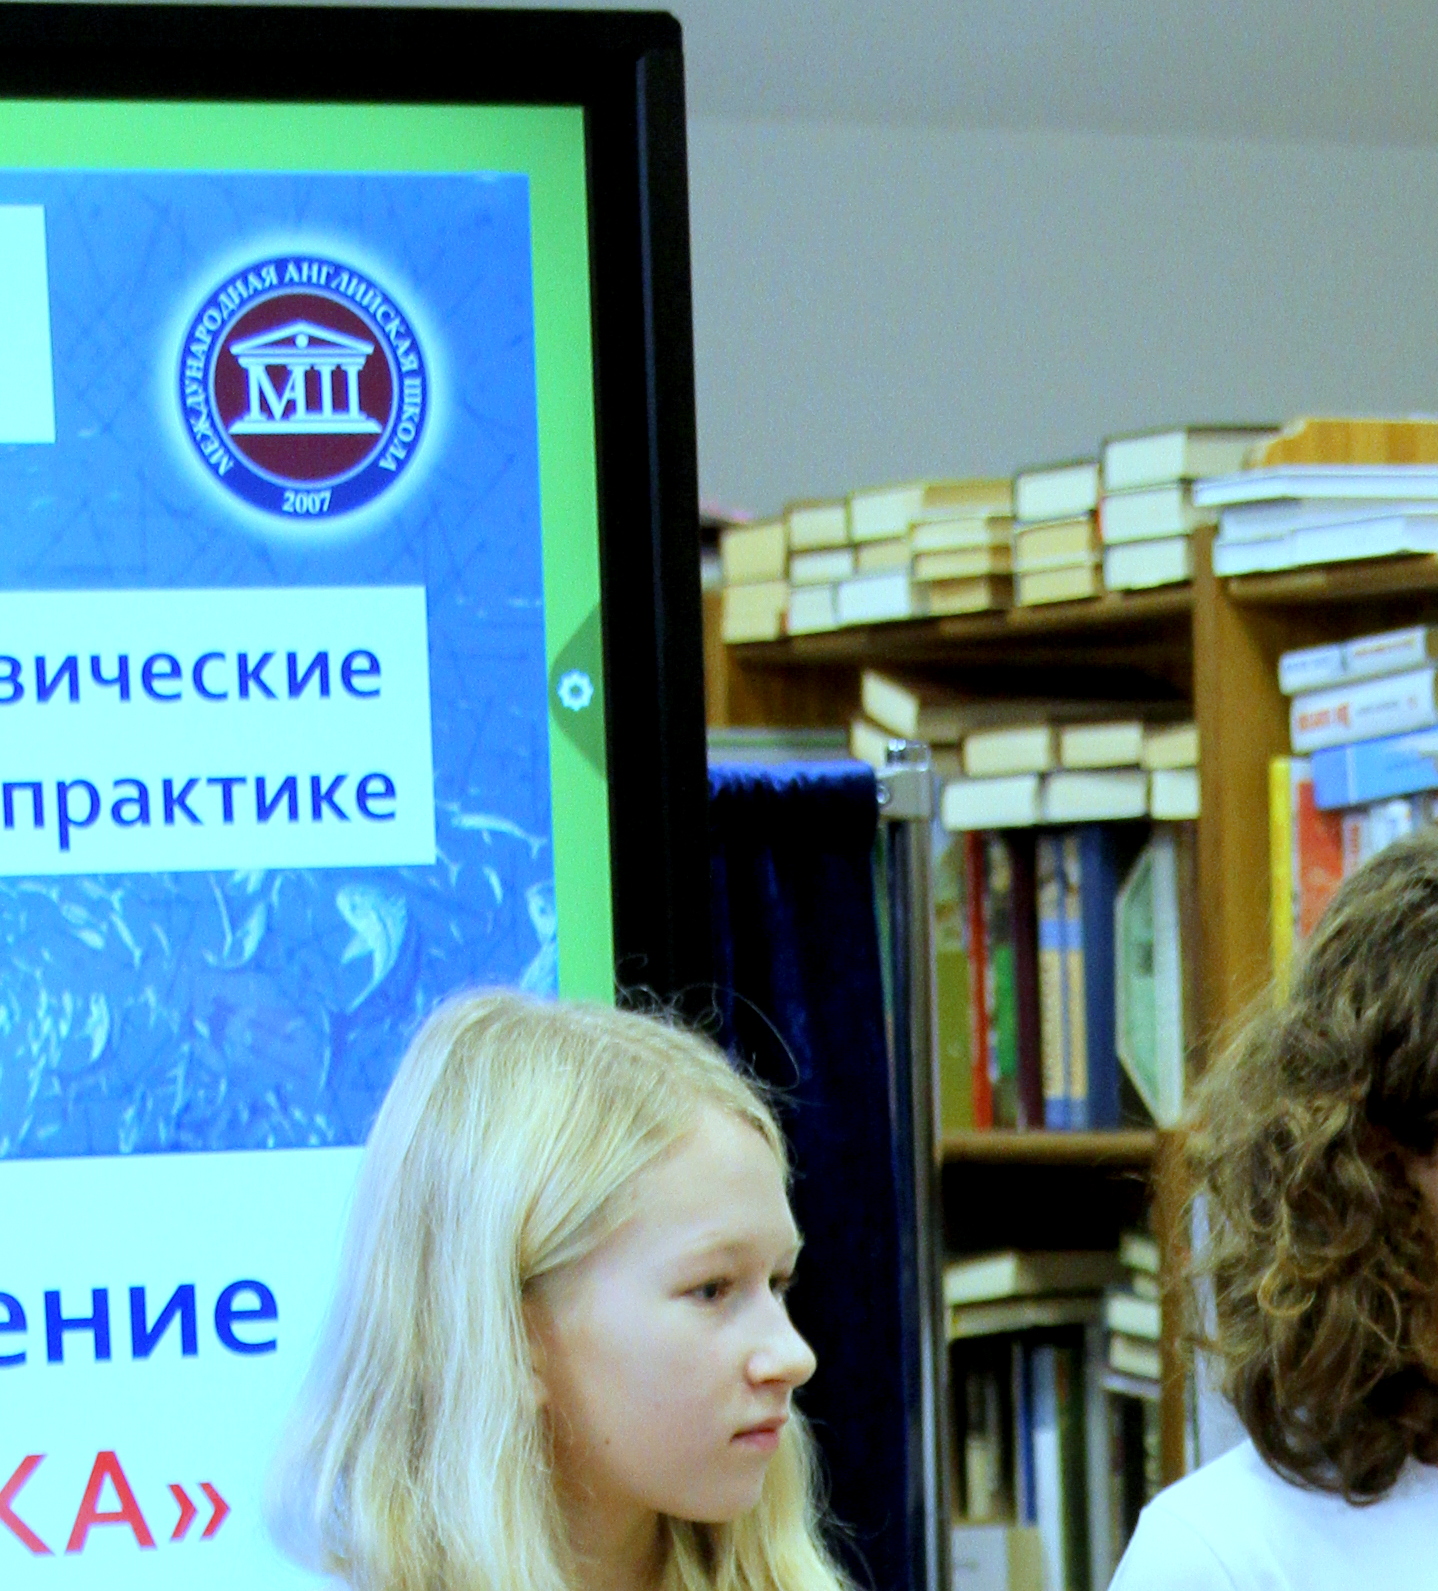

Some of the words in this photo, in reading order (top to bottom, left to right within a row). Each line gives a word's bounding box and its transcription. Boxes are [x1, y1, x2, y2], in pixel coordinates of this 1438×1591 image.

[184, 263, 278, 477] МЕЖДУНАРОДНАЯ
[283, 260, 420, 372] АНГЛИЙСКАЯ
[378, 376, 423, 472] ШКОЛА
[281, 488, 332, 515] 2007
[2, 771, 398, 853] практике
